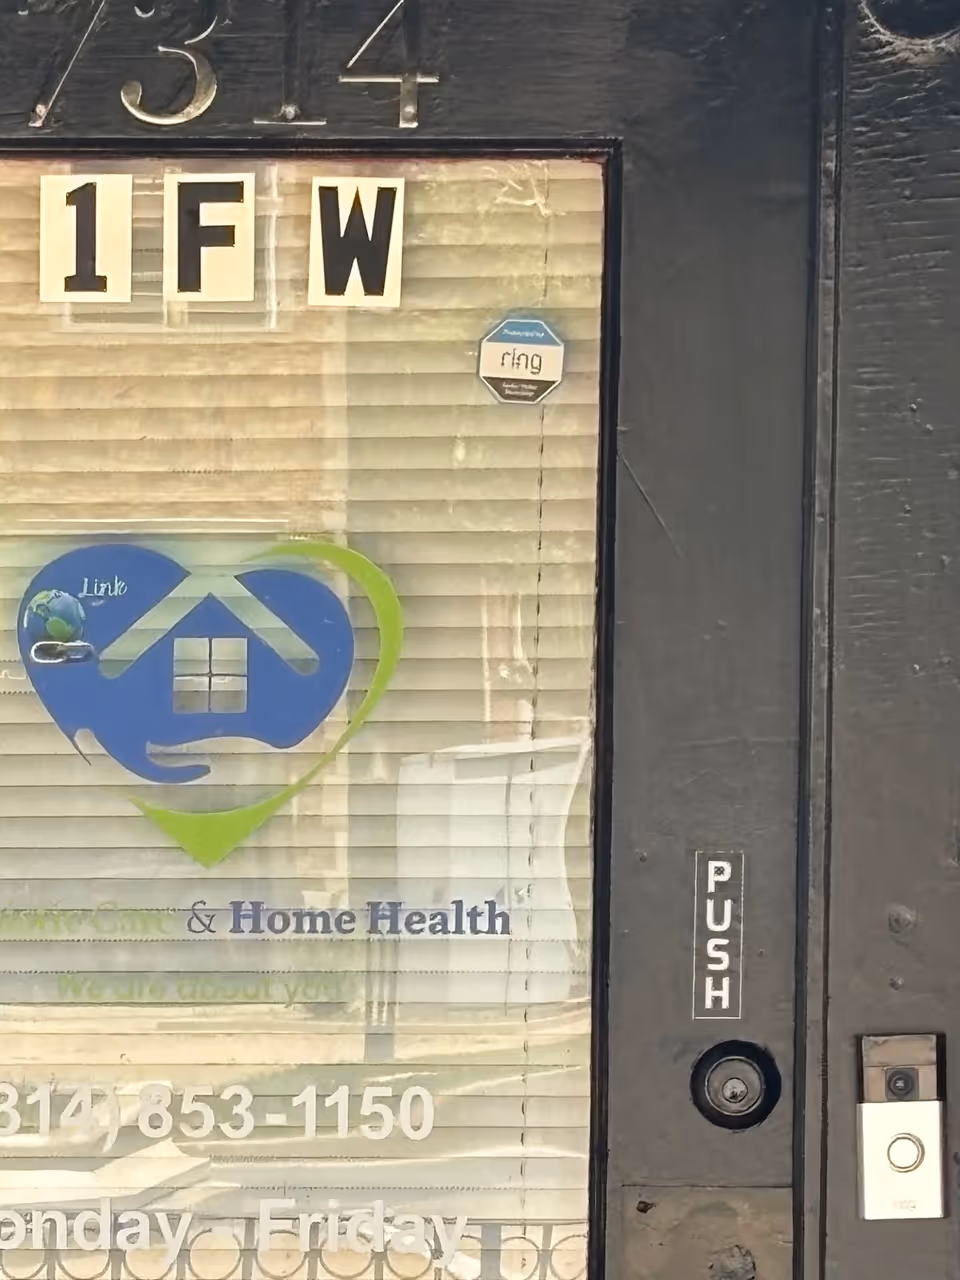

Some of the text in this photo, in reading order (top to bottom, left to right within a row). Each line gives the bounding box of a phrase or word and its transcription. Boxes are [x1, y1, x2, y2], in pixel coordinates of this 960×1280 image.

[65, 181, 397, 296] 1 F W
[501, 348, 542, 376] ring
[78, 575, 128, 598] Link
[187, 899, 217, 934] &
[229, 900, 356, 935] Home
[366, 899, 511, 935] Health
[705, 860, 732, 1009] PUSH
[137, 1083, 435, 1140] 853-1150
[258, 1198, 468, 1268] Friday
